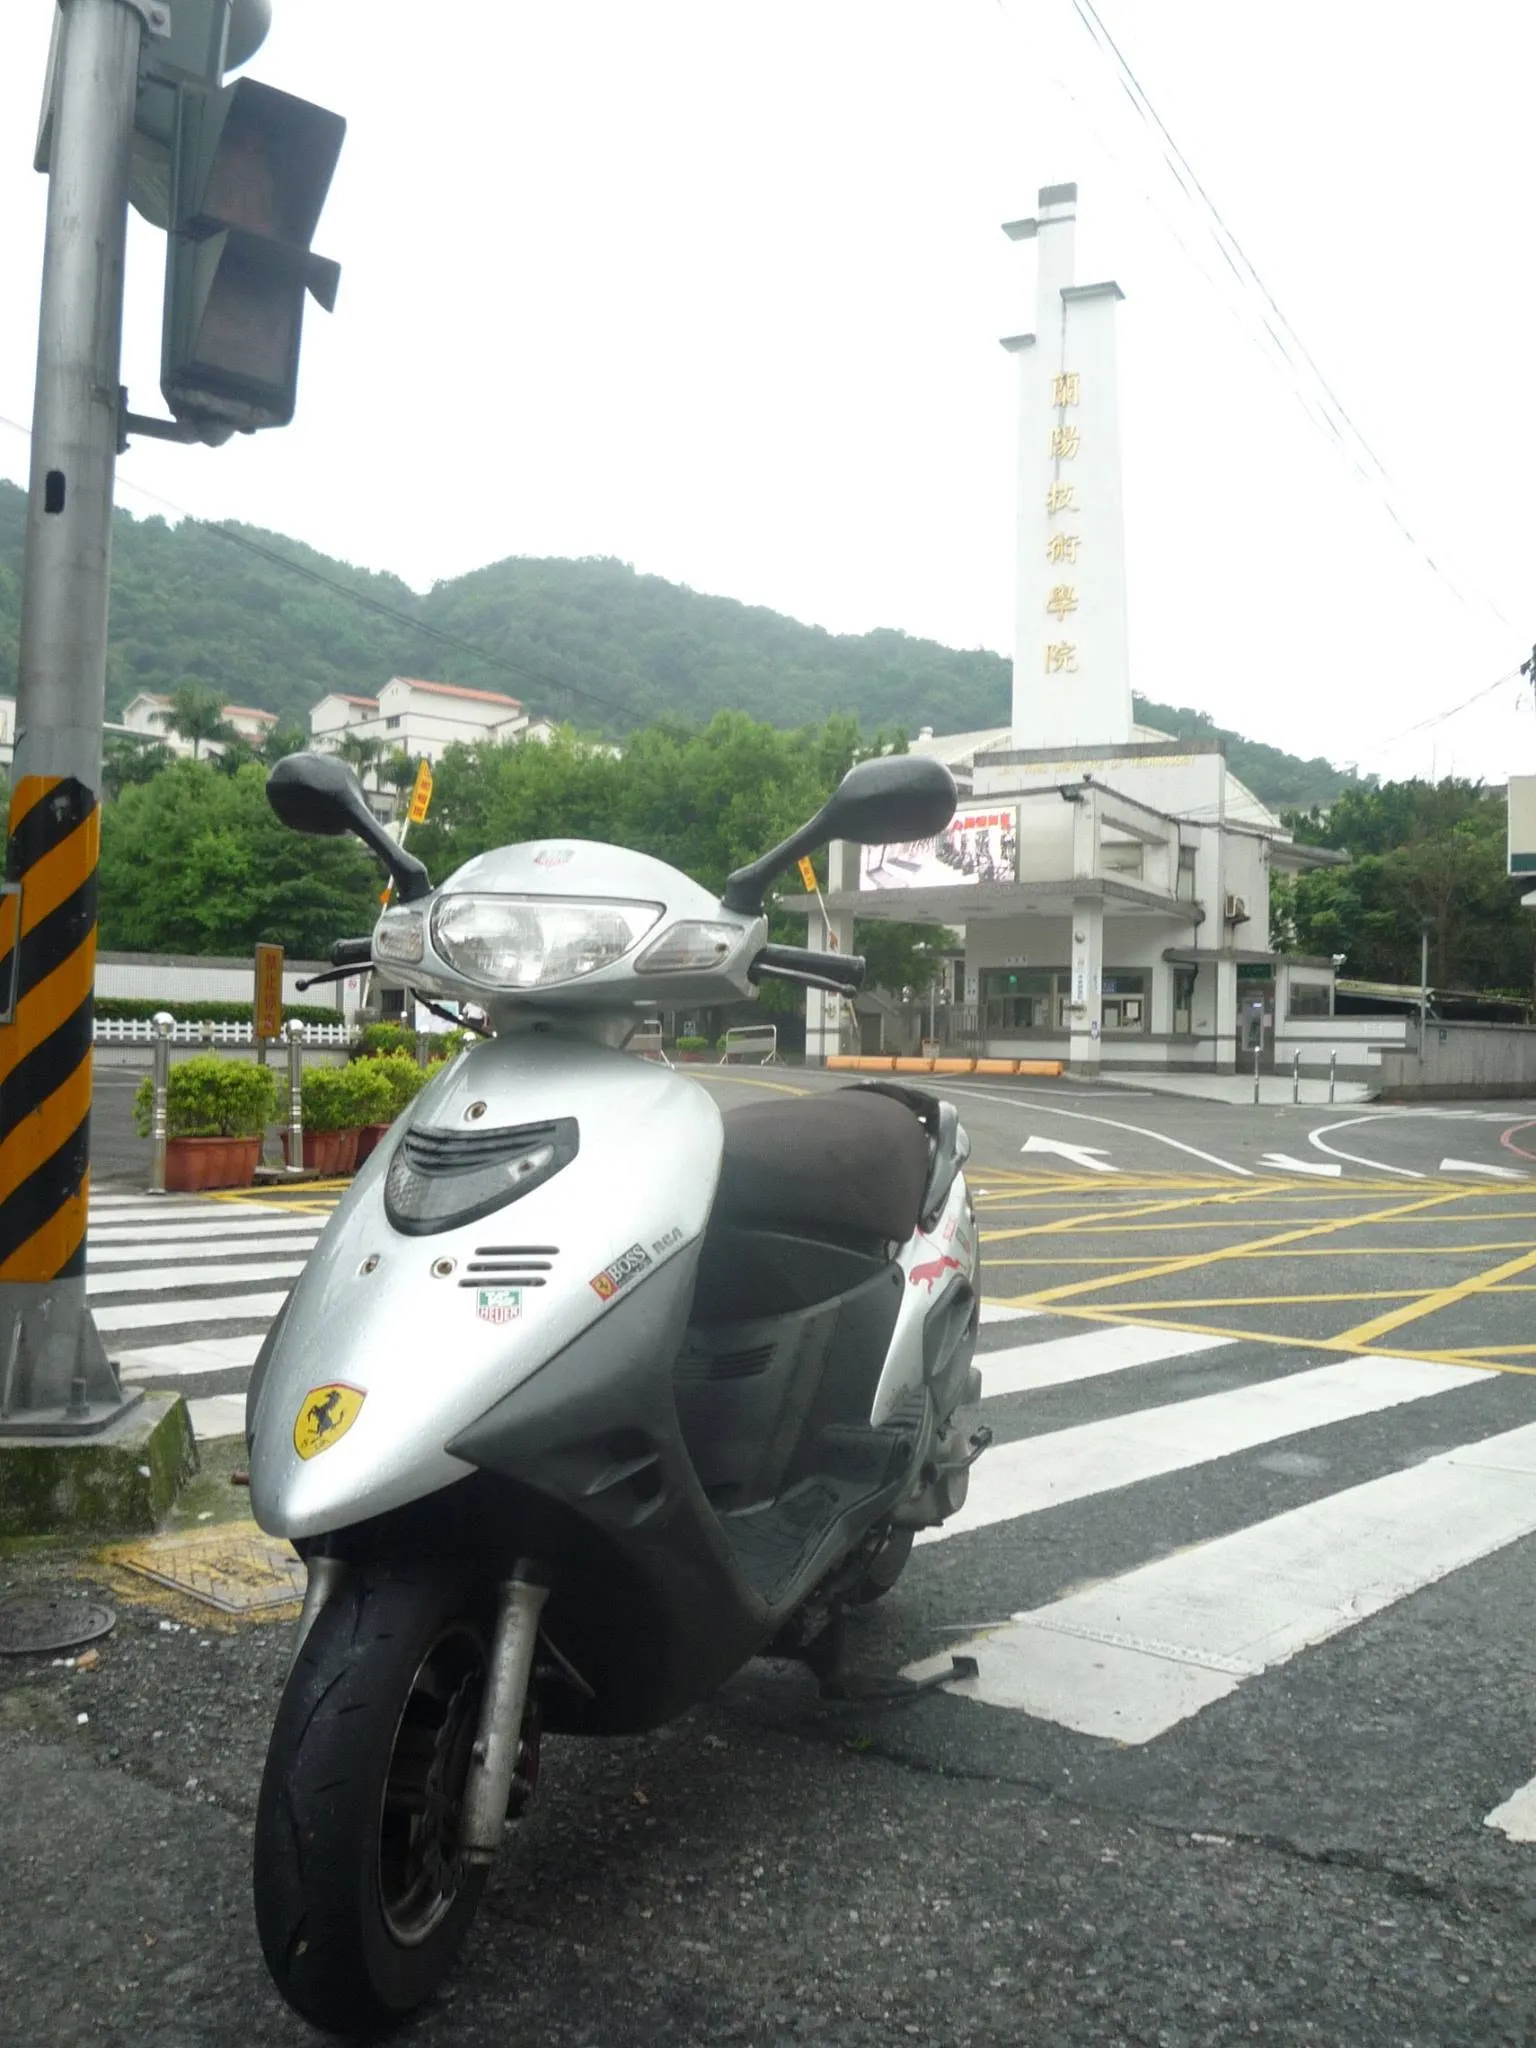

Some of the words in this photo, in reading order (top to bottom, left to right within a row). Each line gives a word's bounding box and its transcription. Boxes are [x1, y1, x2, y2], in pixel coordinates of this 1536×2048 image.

[1044, 370, 1081, 675] 蘭陽技術學院
[606, 1244, 647, 1282] BOSS
